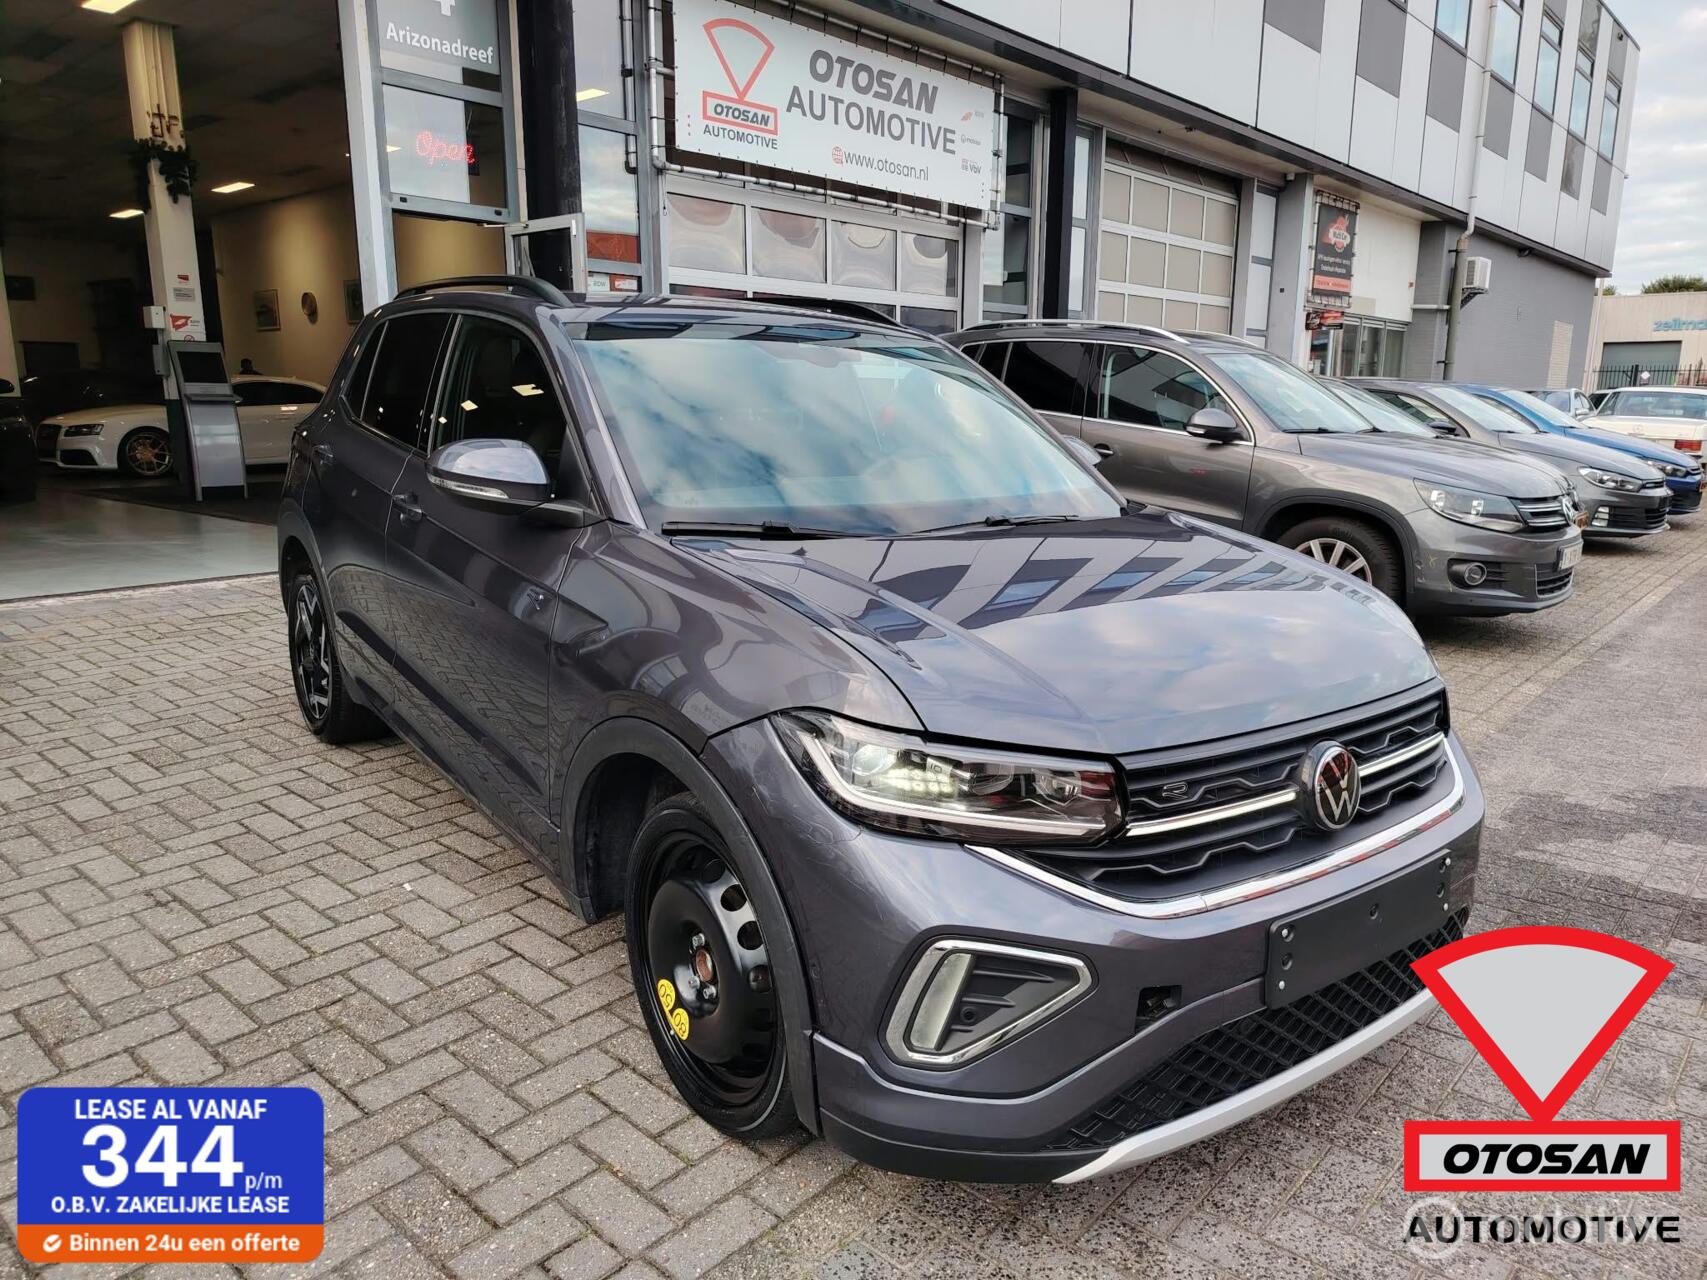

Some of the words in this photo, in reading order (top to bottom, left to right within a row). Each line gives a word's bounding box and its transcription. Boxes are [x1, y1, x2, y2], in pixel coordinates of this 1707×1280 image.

[386, 22, 494, 64] Arizonadreef
[809, 49, 939, 114] OTOSAN
[713, 103, 770, 127] OTOSAN
[785, 85, 956, 155] AUTOMOTIVE
[416, 131, 475, 165] Open
[703, 124, 778, 150] AUTOMOTIVE
[844, 151, 929, 181] www.otosan.nl
